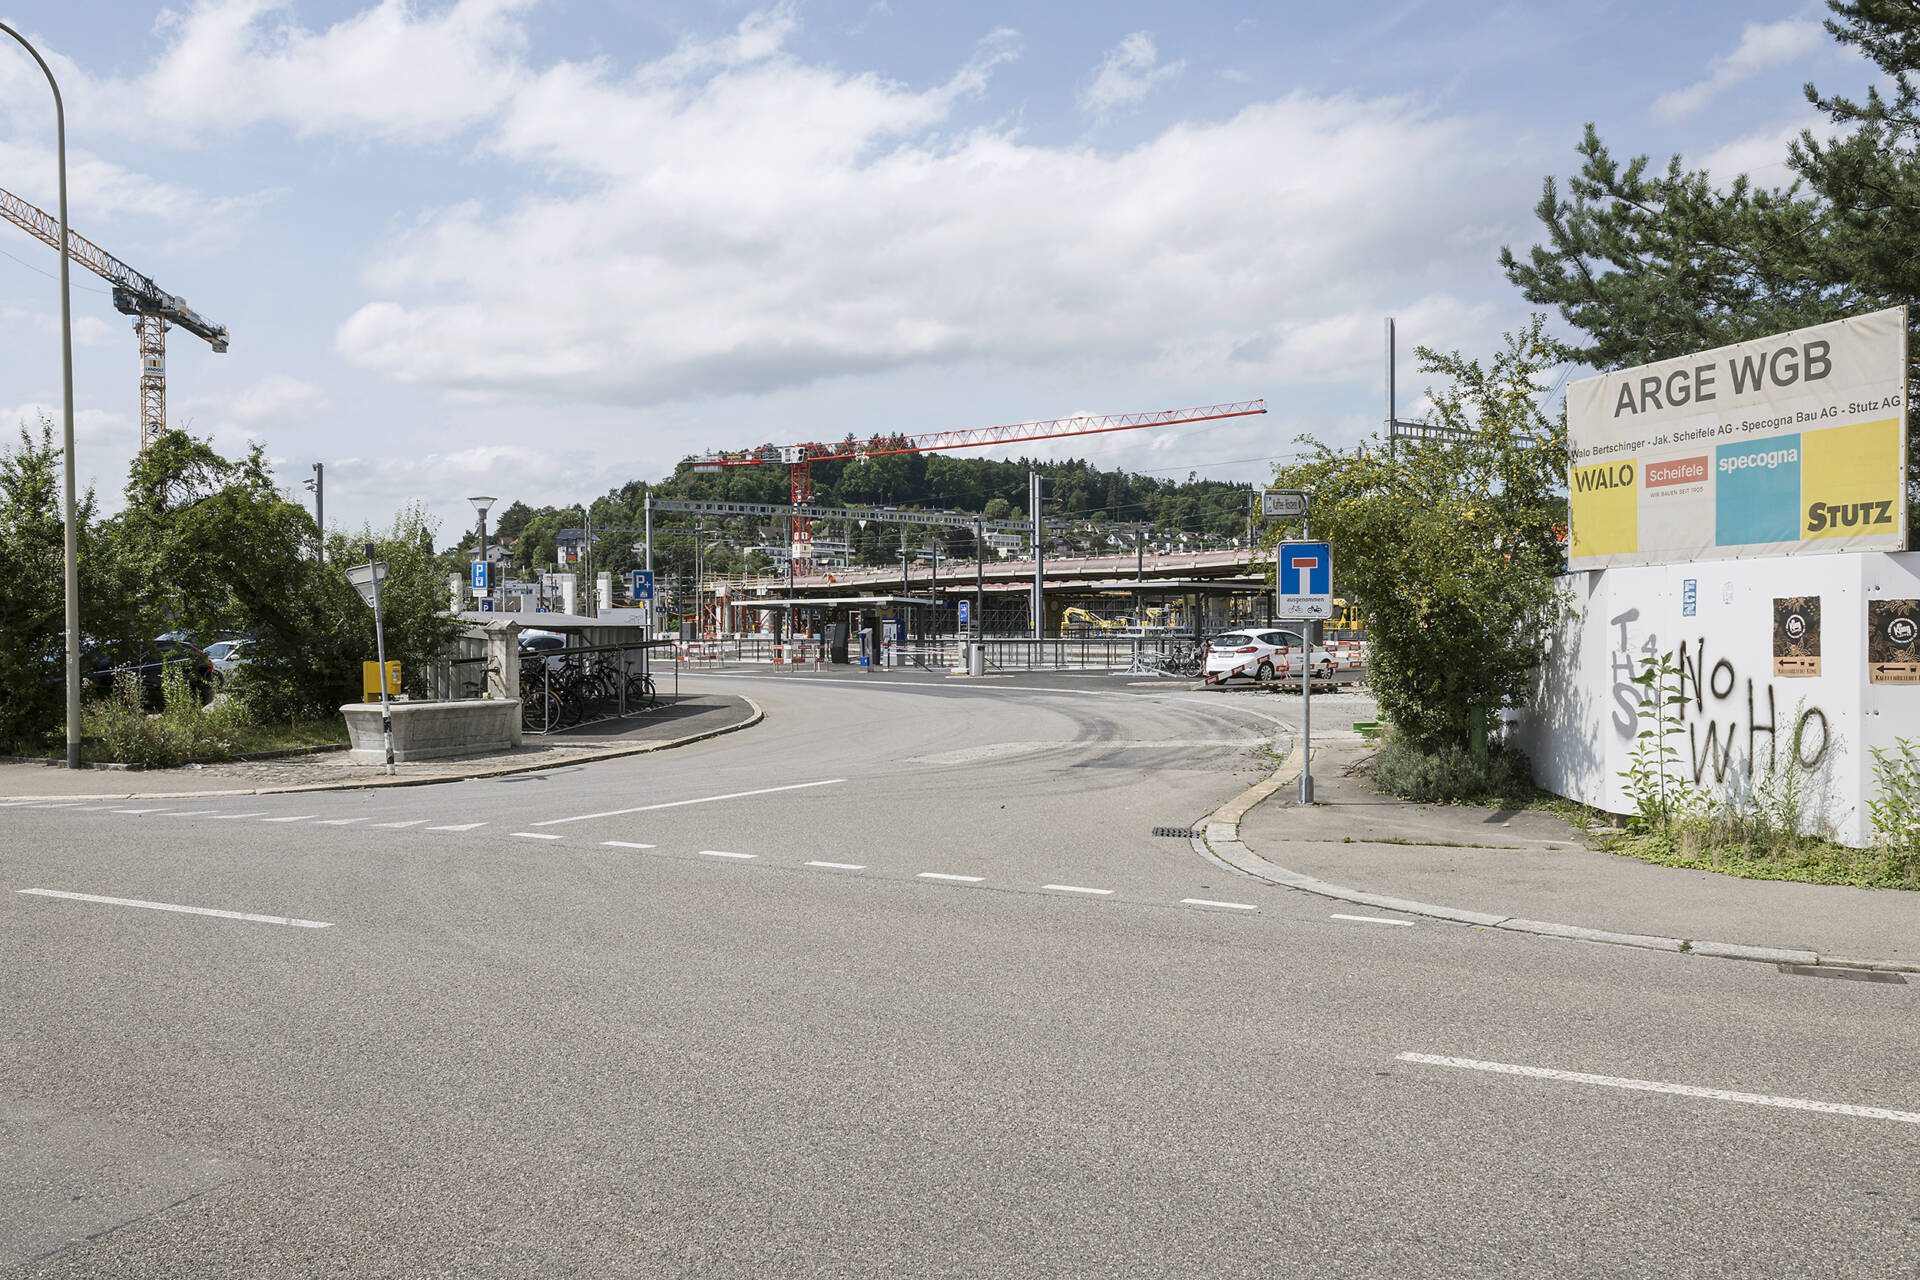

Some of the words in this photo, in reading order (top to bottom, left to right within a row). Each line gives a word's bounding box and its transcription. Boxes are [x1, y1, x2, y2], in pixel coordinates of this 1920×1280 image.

[1614, 364, 1717, 418] ARGE
[1729, 340, 1832, 394] WGB
[152, 425, 158, 433] 2
[1571, 448, 1590, 459] Walo
[1593, 440, 1645, 455] Bertschinger
[1652, 435, 1670, 446] Jak.
[1674, 427, 1715, 442] Scheifele
[1717, 424, 1732, 435] AG
[1741, 415, 1792, 432] Specogna
[1797, 412, 1817, 423] Bau
[1820, 406, 1838, 419] AG
[1849, 402, 1878, 414] Stutz
[1882, 395, 1901, 408] AG
[1649, 464, 1704, 482] Scheifele
[1719, 447, 1798, 473] specogna
[1575, 464, 1634, 493] WALO
[1808, 500, 1893, 532] STUTZ
[476, 565, 483, 576] P
[1690, 678, 1829, 785] WHO
